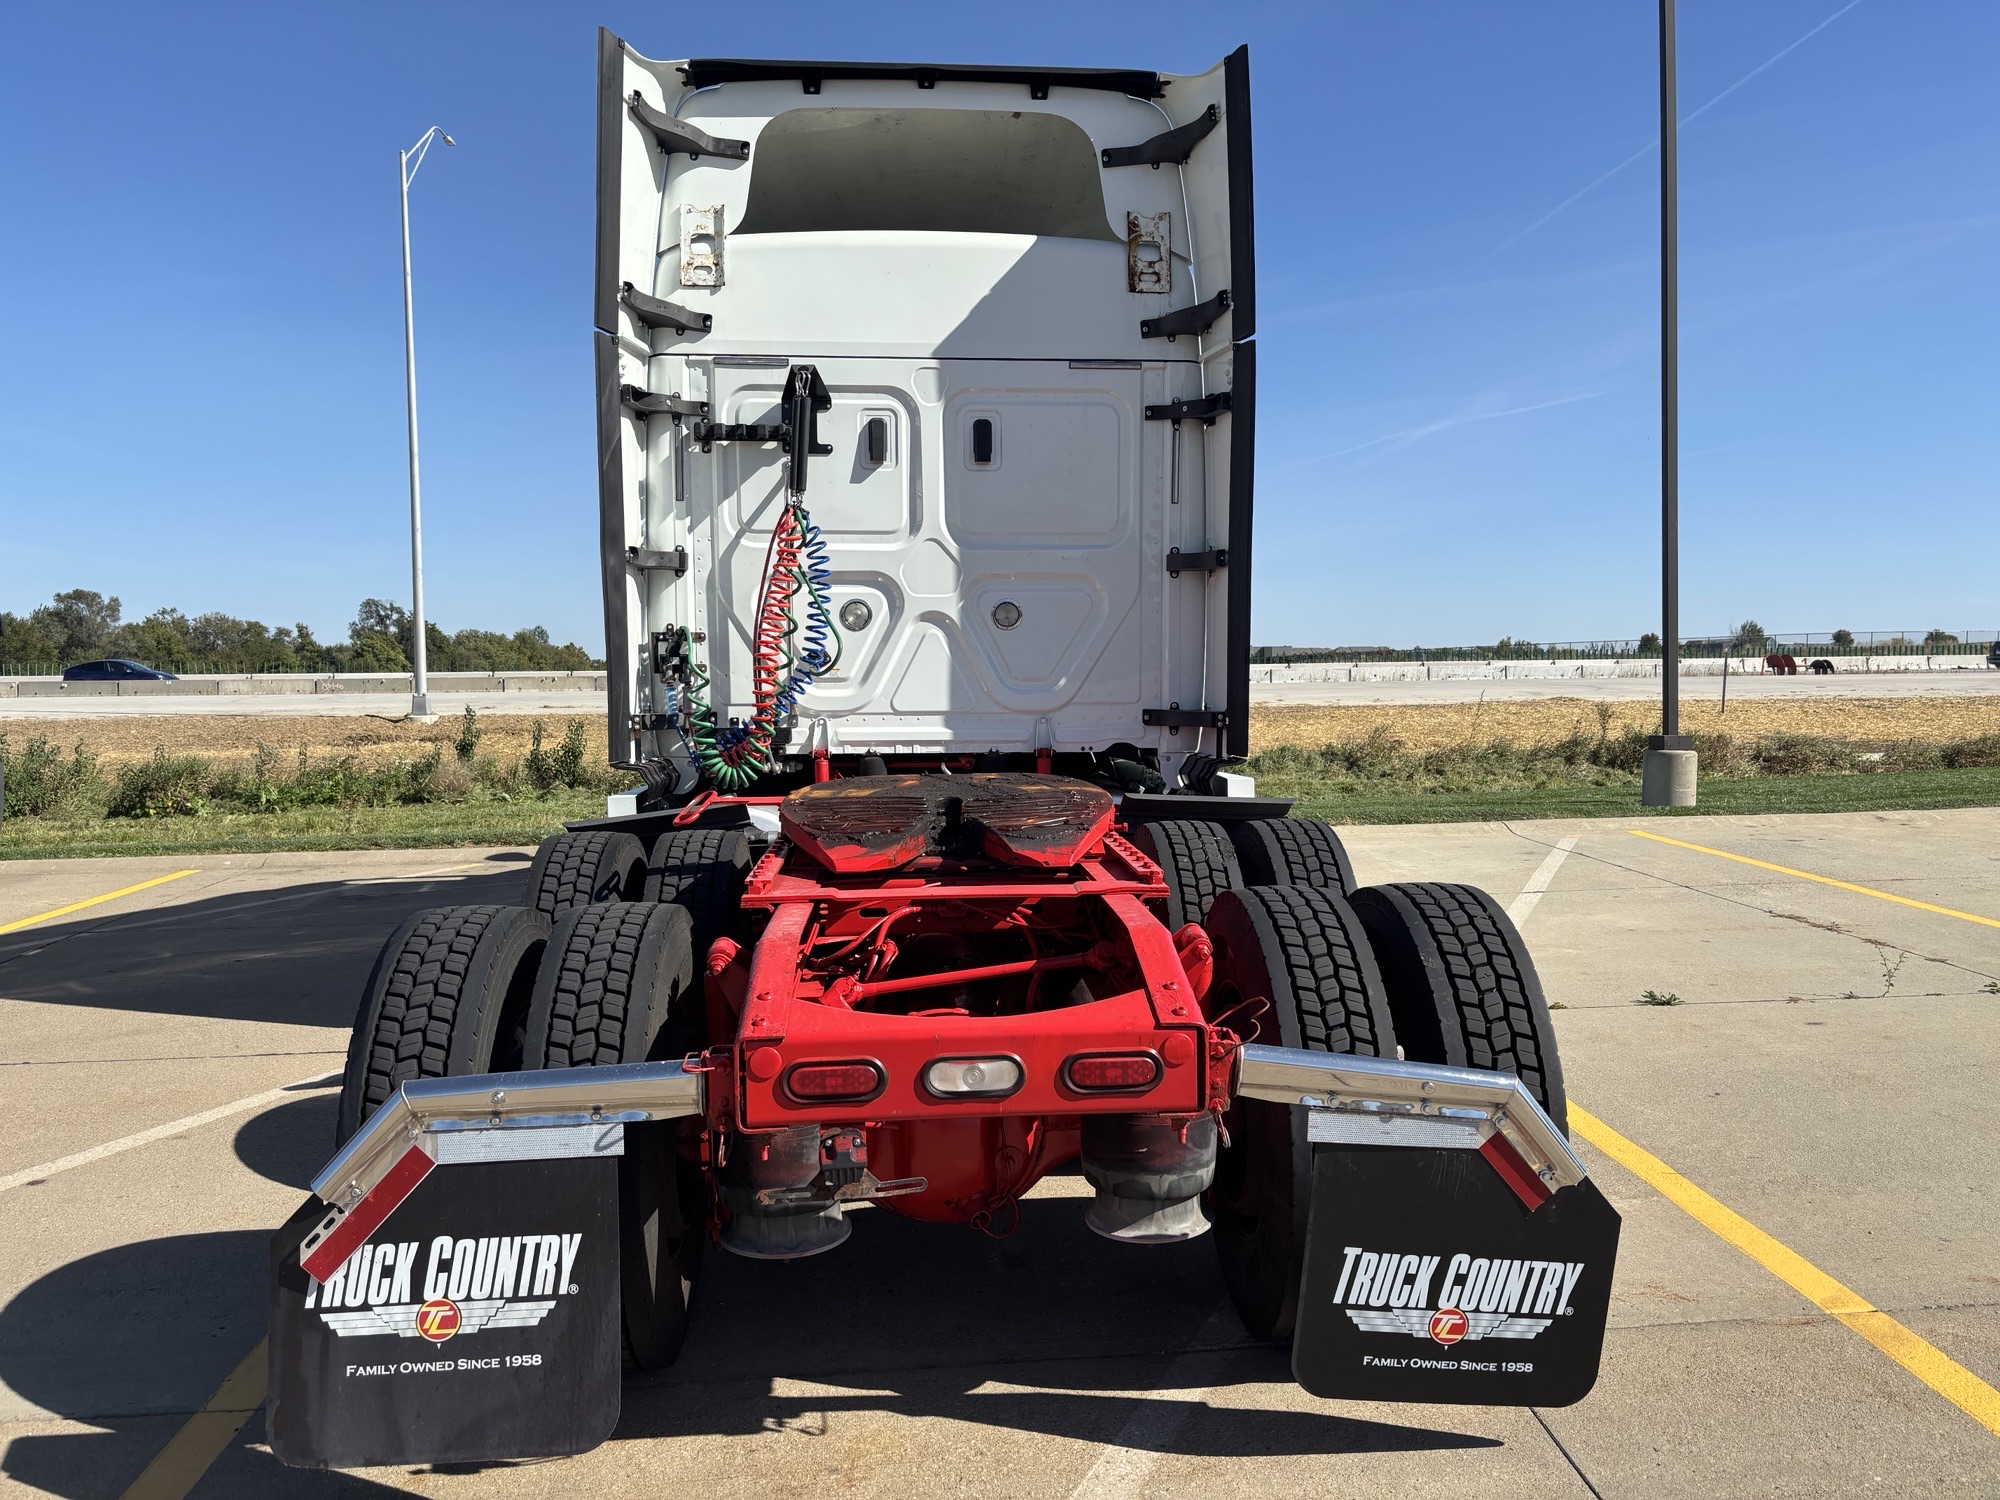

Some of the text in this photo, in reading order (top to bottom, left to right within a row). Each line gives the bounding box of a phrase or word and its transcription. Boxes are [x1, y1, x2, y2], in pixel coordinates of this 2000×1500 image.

[1333, 1247, 1441, 1309] TRUCK
[420, 1305, 456, 1335] TC
[1433, 1314, 1464, 1338] TC
[346, 1353, 543, 1377] FAMILY OWNED SINCE 1958
[1363, 1355, 1534, 1373] FAMILY OWNED SINCE 1958
